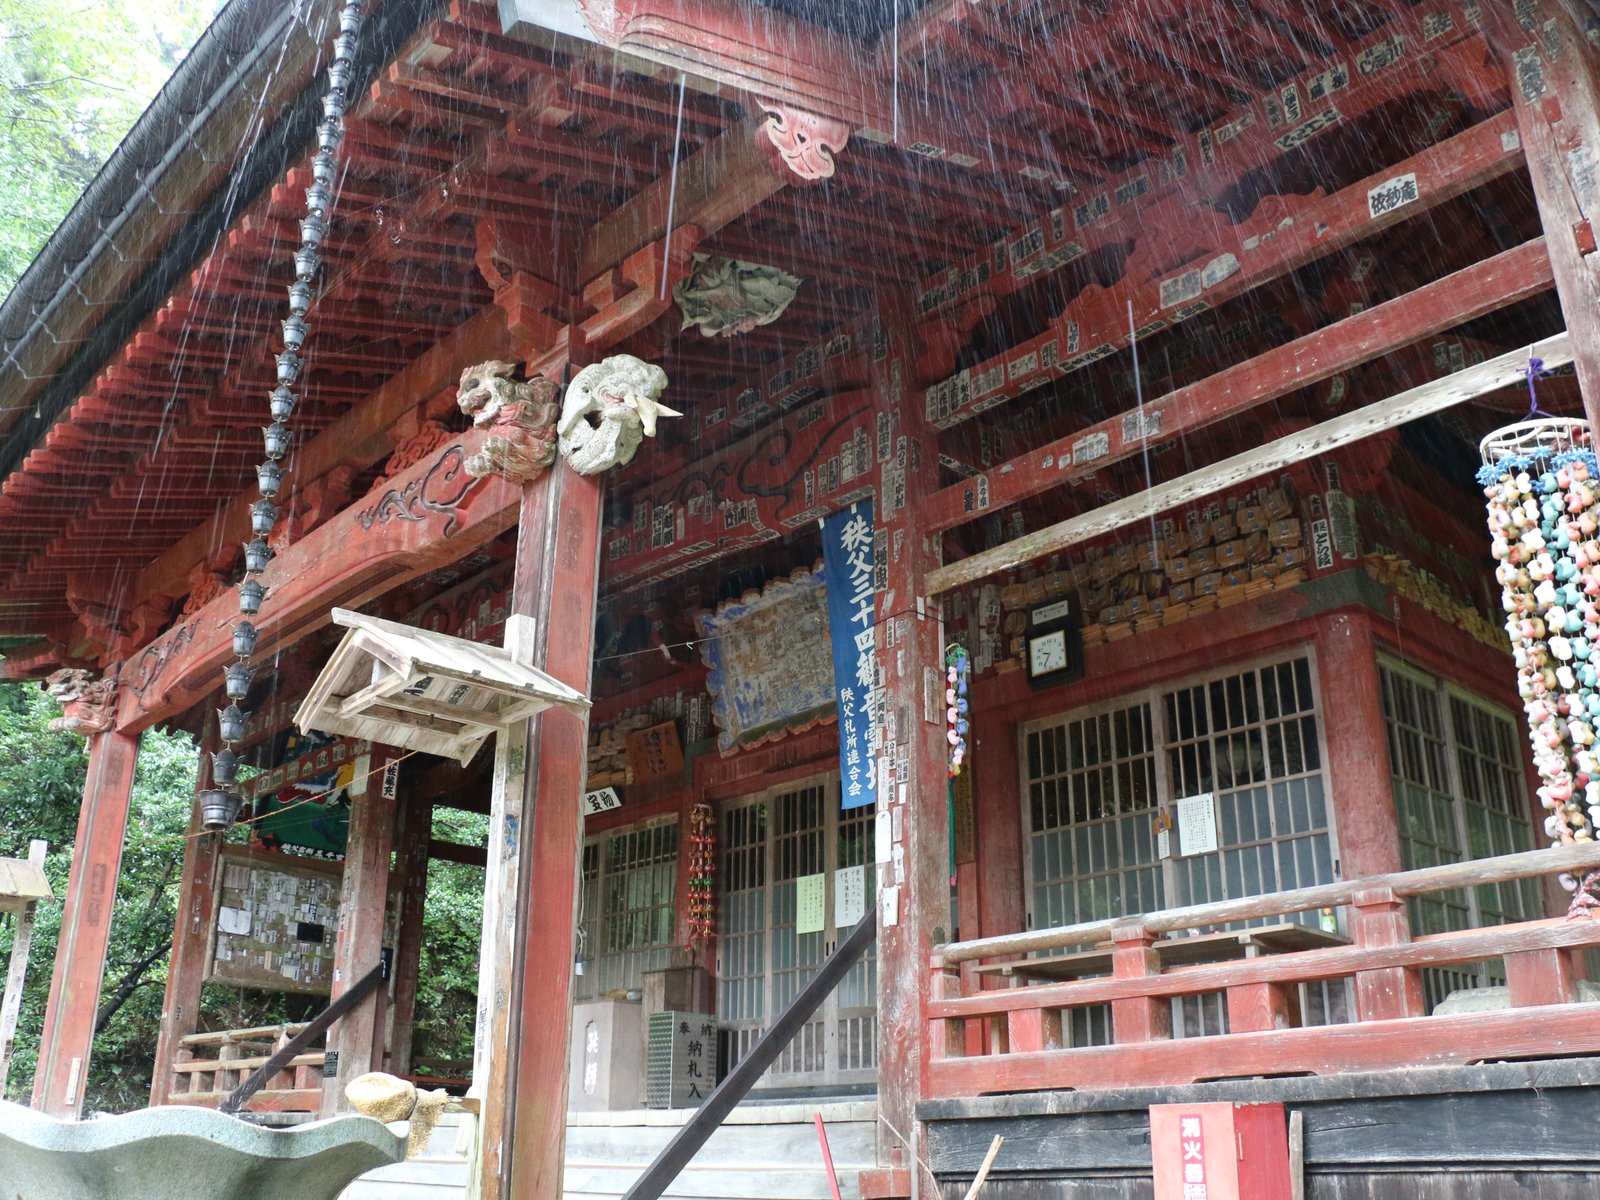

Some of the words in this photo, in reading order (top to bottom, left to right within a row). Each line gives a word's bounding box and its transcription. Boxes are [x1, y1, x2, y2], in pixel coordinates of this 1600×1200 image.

[840, 687, 862, 796] 秩父札所連合会
[687, 1040, 702, 1099] 納札入
[1181, 1117, 1203, 1183] 消火器
